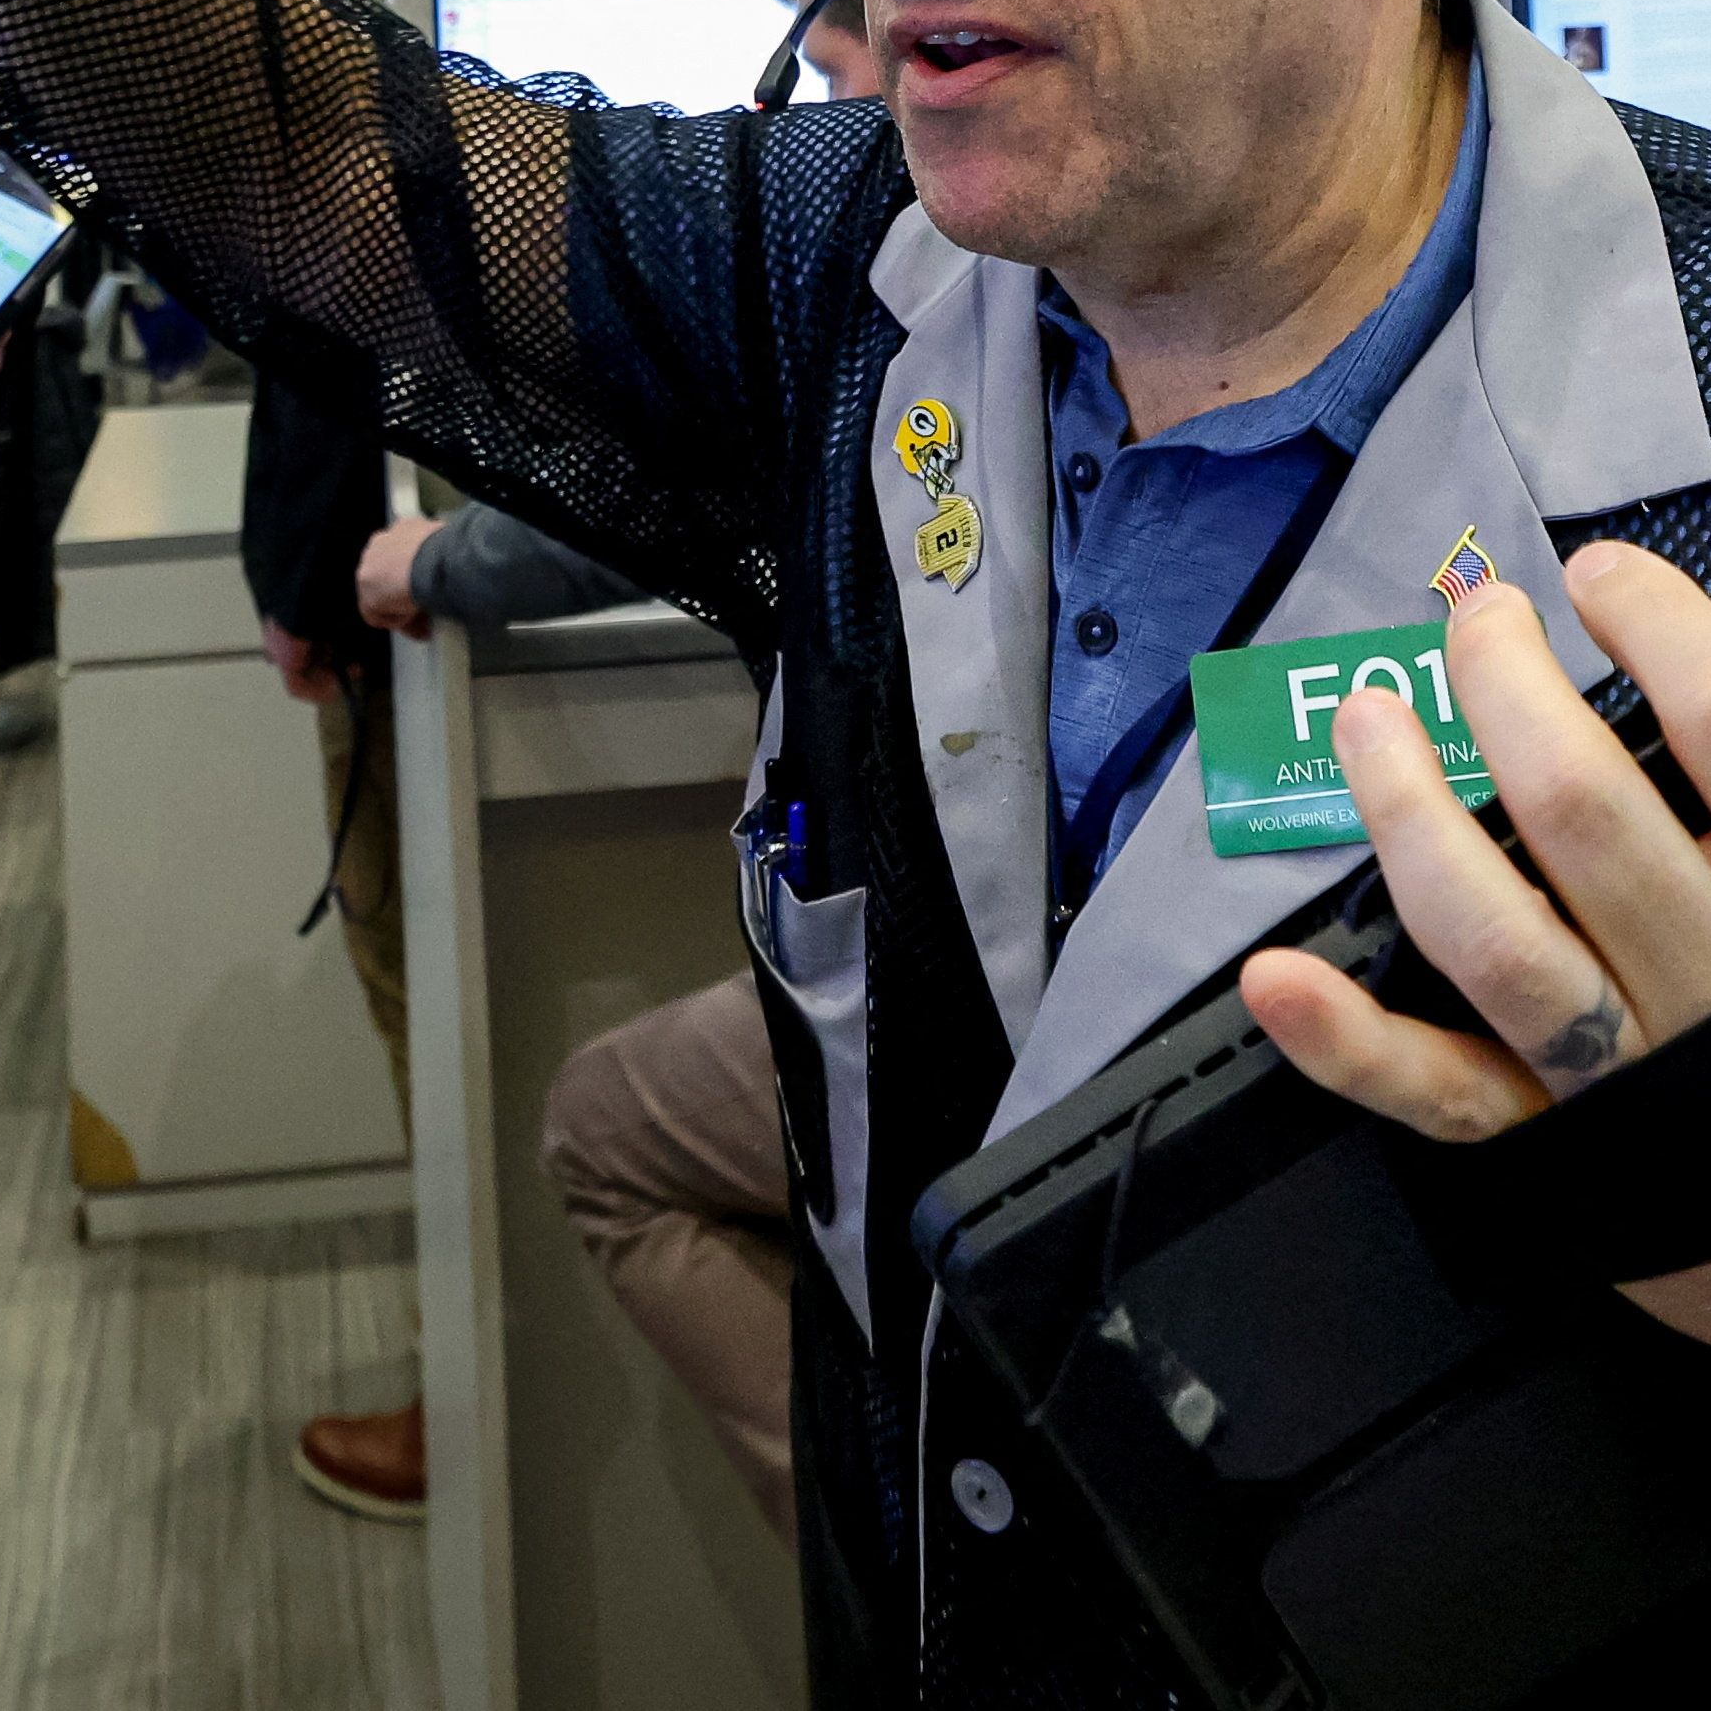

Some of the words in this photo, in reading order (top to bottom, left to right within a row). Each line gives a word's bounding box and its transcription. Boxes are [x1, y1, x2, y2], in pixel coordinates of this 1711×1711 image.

[935, 527, 959, 554] 2
[1276, 756, 1343, 787] ANTH
[1247, 809, 1336, 834] WOLVERINE
